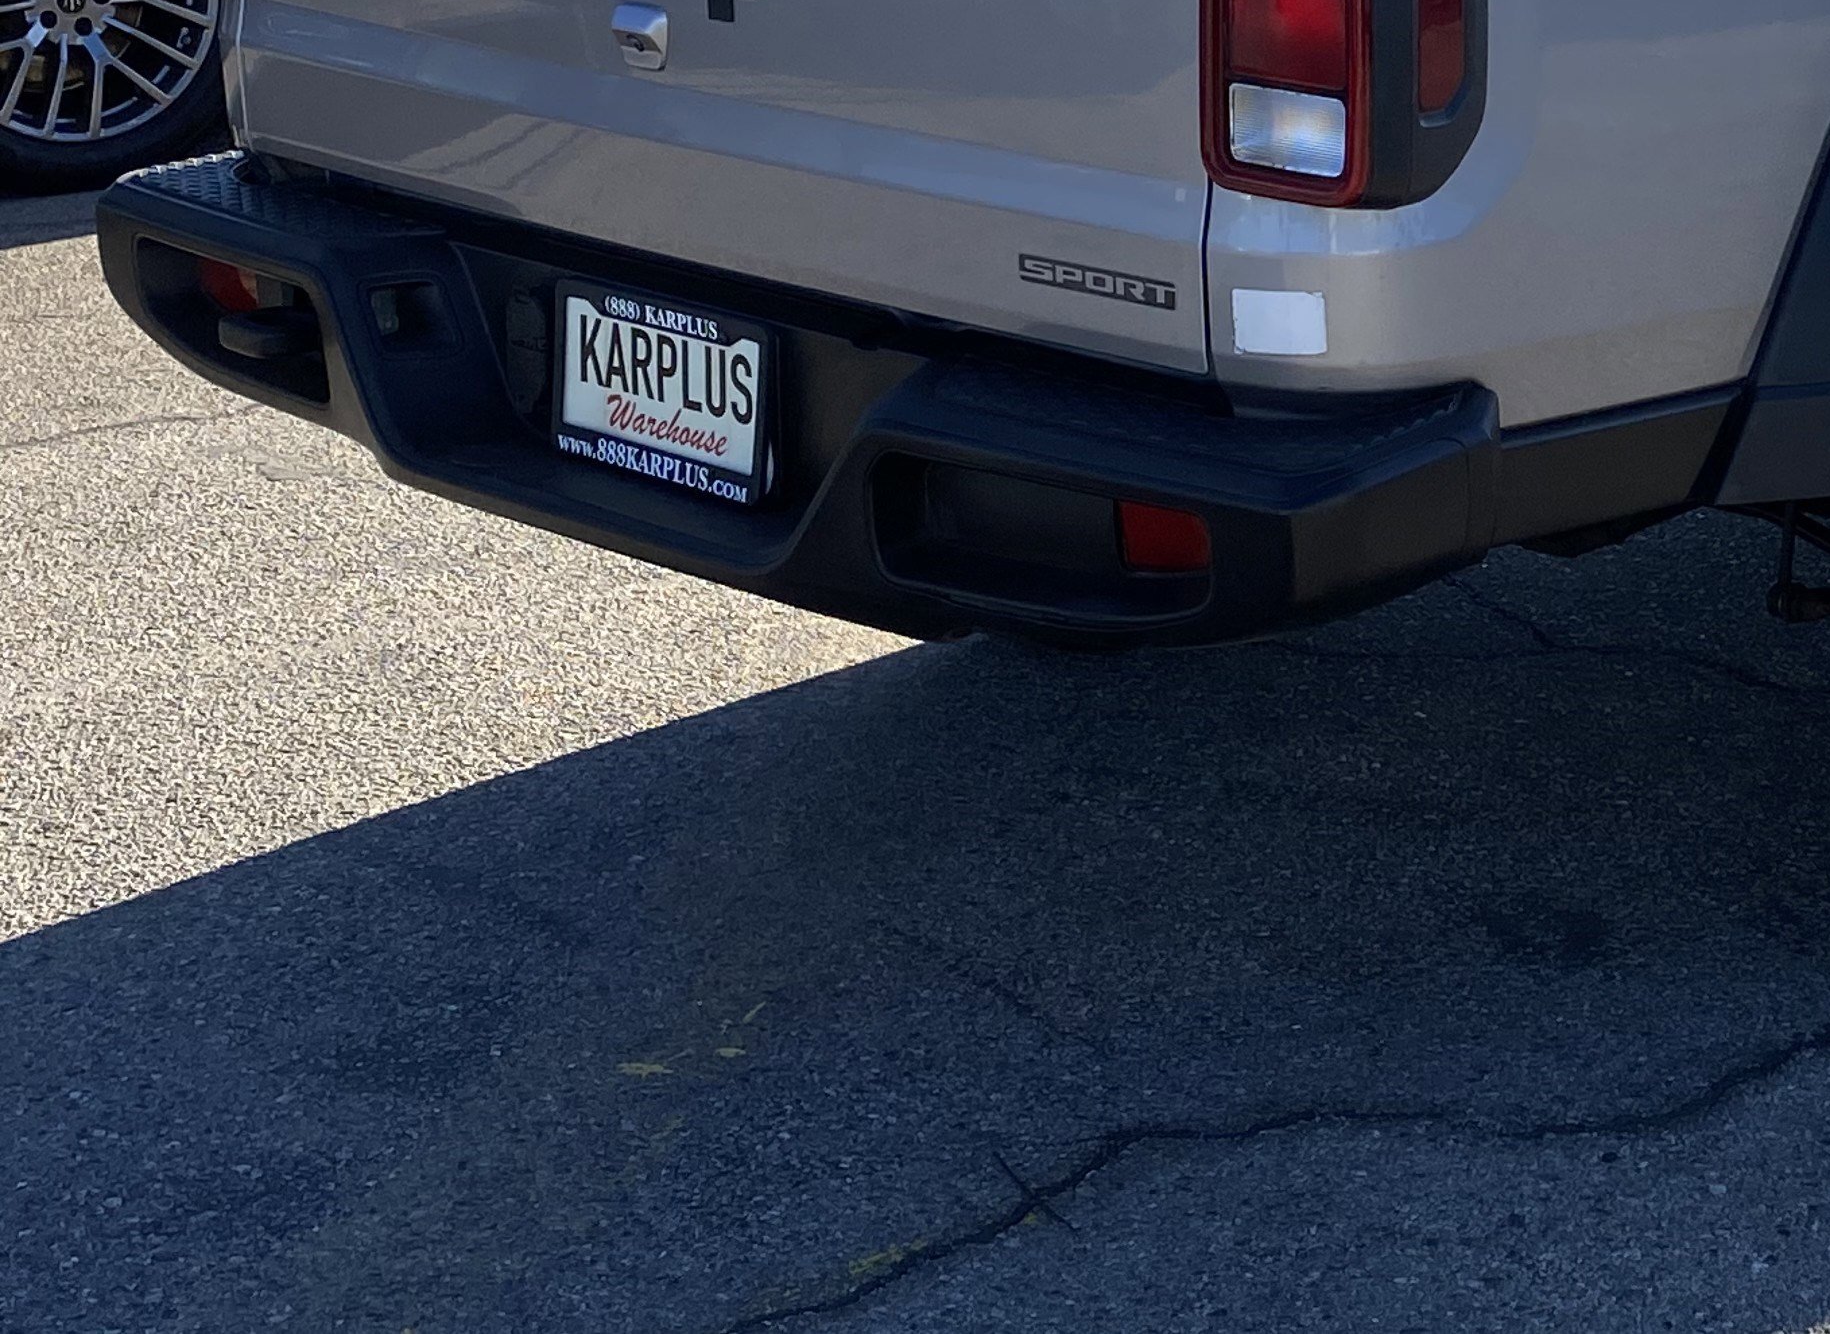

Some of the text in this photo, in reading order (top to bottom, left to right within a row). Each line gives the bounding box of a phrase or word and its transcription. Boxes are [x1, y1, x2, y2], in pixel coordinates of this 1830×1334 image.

[1019, 258, 1177, 304] SPORT
[604, 295, 718, 340] (888) KARPLUS
[580, 313, 753, 426] KARPLUS
[607, 394, 729, 457] Warehouse
